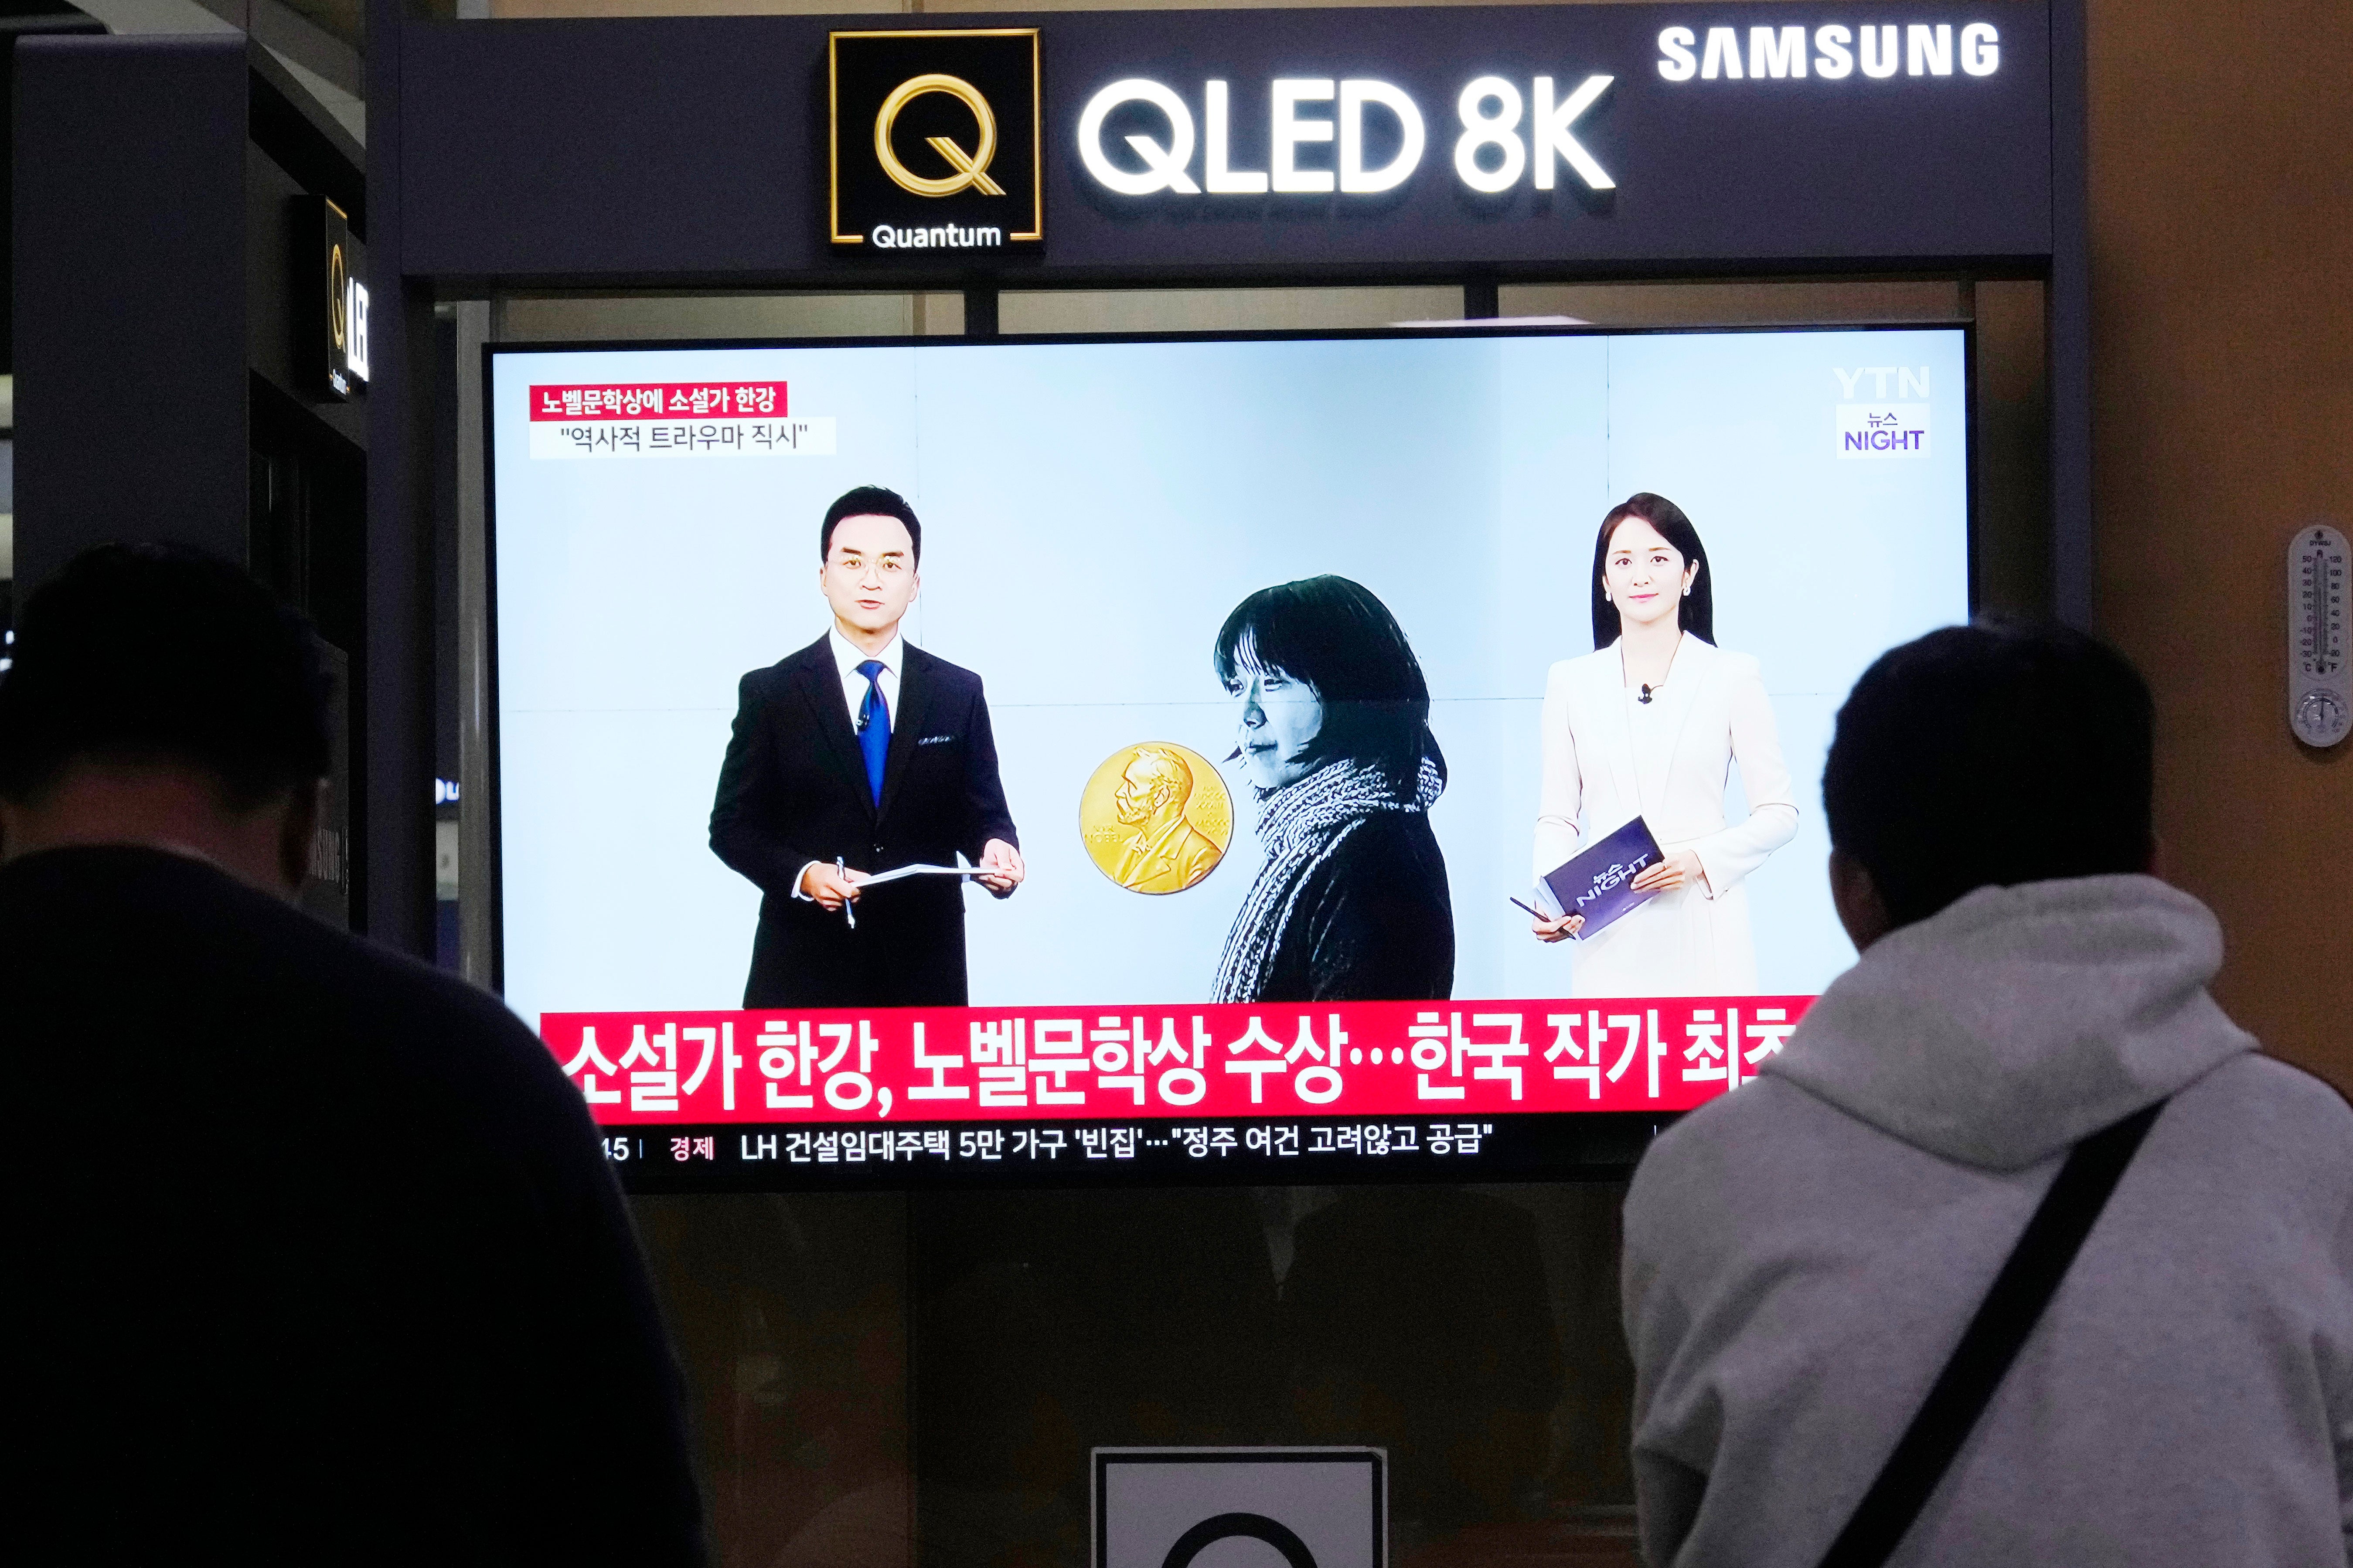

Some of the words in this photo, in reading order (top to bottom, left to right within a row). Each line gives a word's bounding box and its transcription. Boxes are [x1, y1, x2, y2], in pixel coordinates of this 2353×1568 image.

[1658, 23, 1999, 81] SAMSUNG
[874, 73, 1006, 197] Q
[1078, 78, 1425, 195] QLED
[1455, 76, 1616, 192] 8K
[872, 224, 1001, 248] Quantum
[1832, 366, 1930, 398] YTN
[542, 388, 664, 415] 노벨문학상에
[669, 388, 731, 414] 소설가
[735, 386, 777, 413] 한강
[561, 426, 640, 452] "역사적
[650, 425, 745, 451] 트라우마
[752, 423, 808, 450] 직시"
[1867, 412, 1898, 428] 뉴스
[1845, 430, 1924, 450] NIGHT
[1576, 853, 1648, 907] NIGHT
[561, 1022, 743, 1112] 소설가
[757, 1020, 893, 1119] 한강,
[908, 1016, 1212, 1107] 노벨문학상
[1544, 1010, 1668, 1100] 작가
[670, 1136, 714, 1161] 경제
[742, 1135, 777, 1160] LH
[786, 1130, 950, 1163] 건설임대주택
[960, 1129, 1005, 1160] 5만
[1012, 1129, 1068, 1160] 가구
[1246, 1126, 1300, 1157] 여건
[1308, 1124, 1420, 1156] 고려않고
[1426, 1124, 1493, 1155] 공급"
